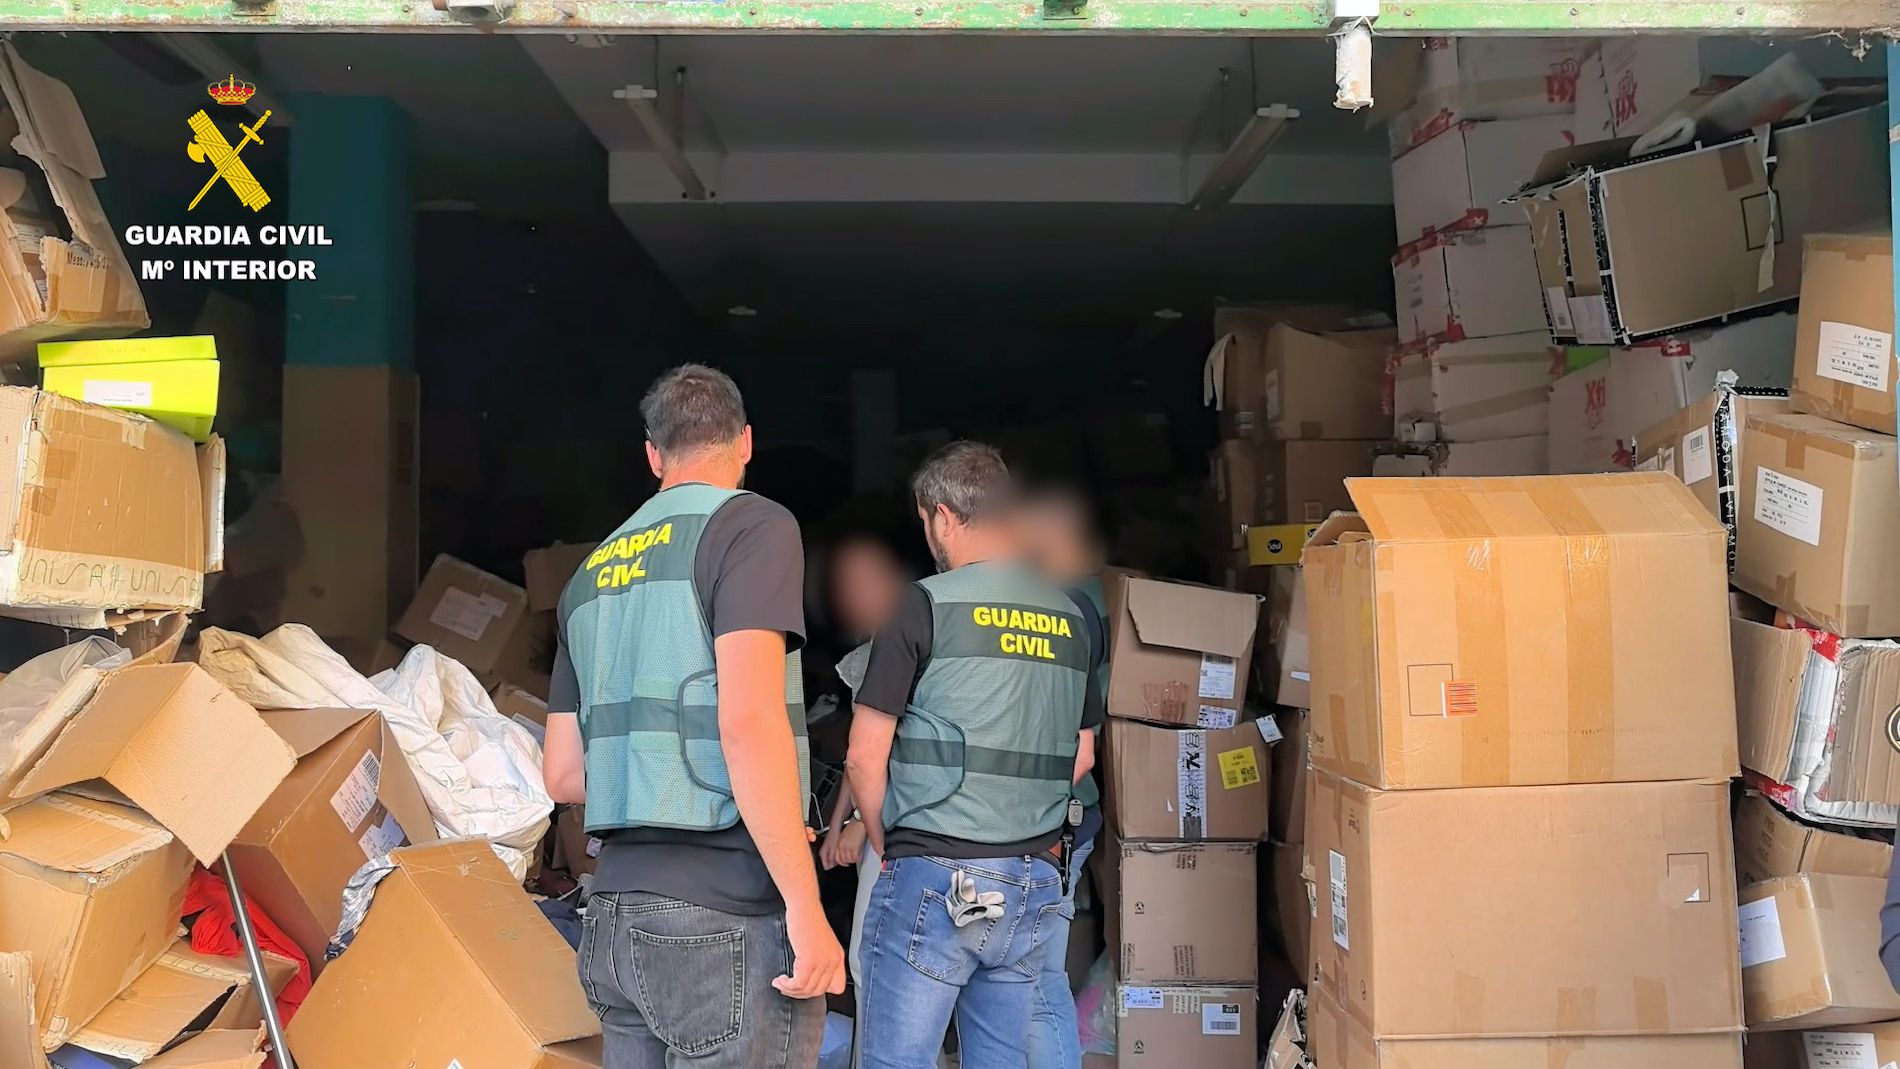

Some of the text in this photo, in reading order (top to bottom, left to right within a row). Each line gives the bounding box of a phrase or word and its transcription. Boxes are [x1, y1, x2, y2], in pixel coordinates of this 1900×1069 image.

[586, 523, 673, 571] GUARDIA
[596, 556, 647, 589] CIVL
[973, 606, 1072, 638] GUARDIA
[1000, 632, 1056, 660] CIVIL
